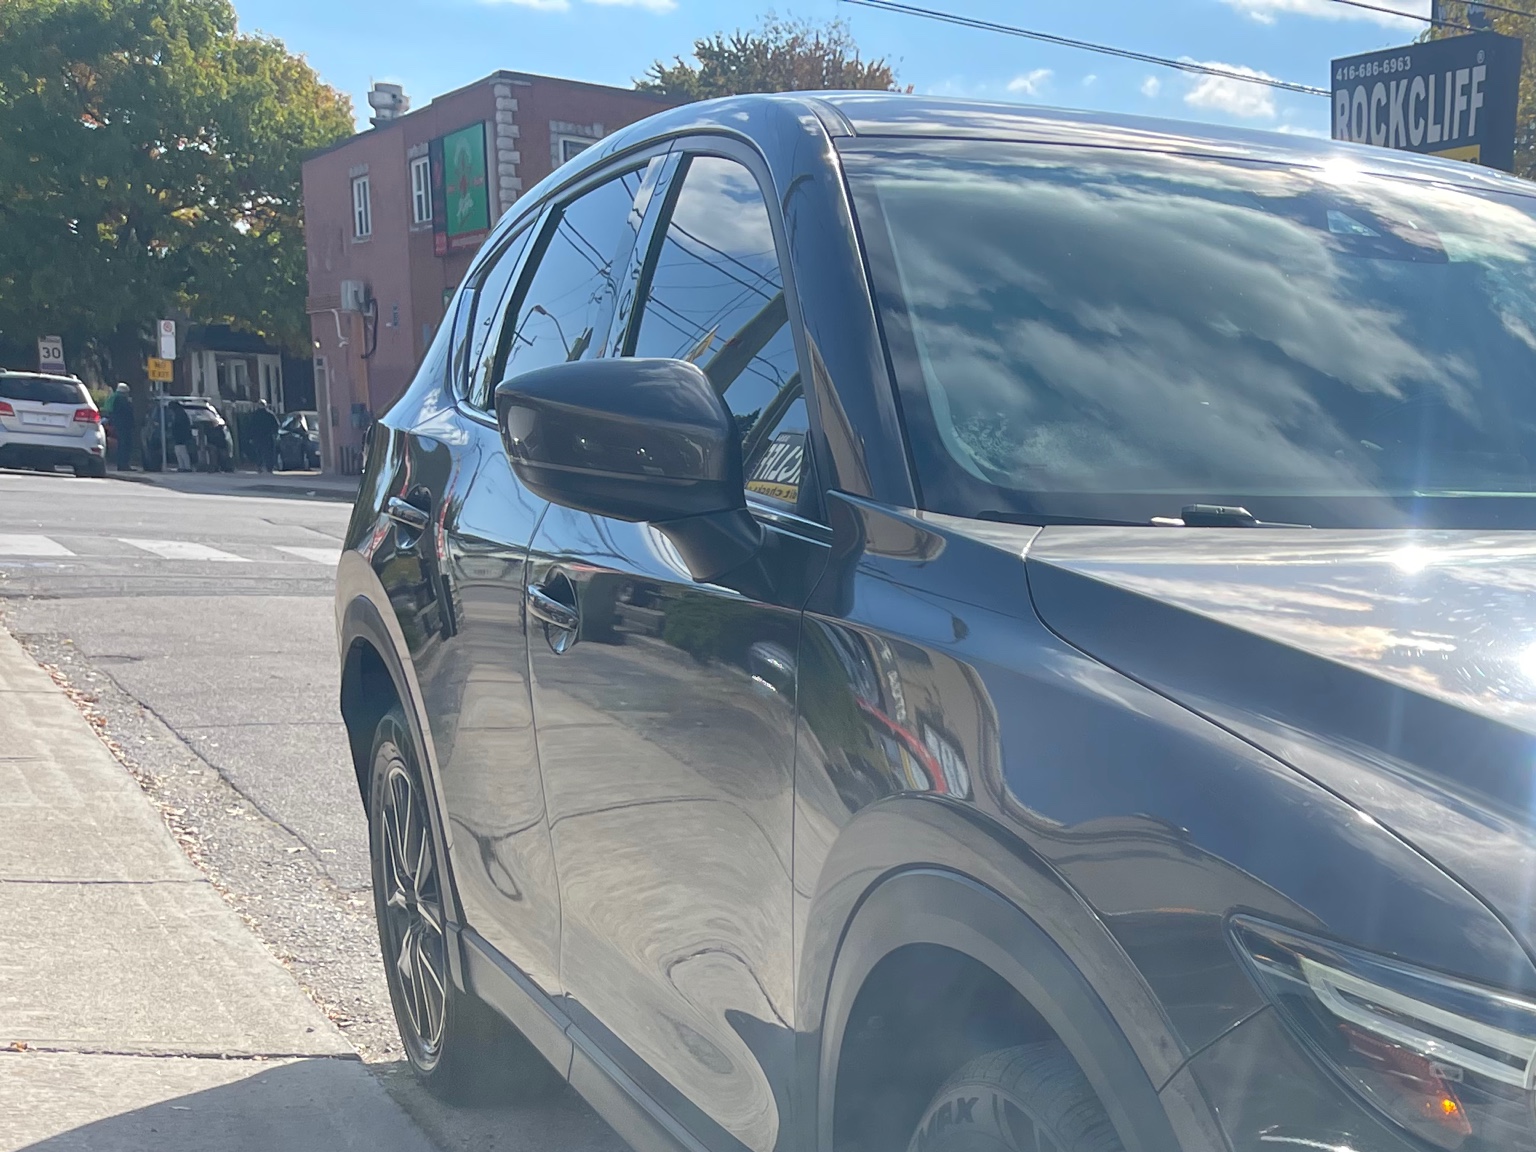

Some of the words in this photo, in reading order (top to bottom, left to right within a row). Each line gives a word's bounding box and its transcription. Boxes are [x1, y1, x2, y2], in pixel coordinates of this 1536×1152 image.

[1335, 55, 1411, 81] 416-686-6963
[1335, 65, 1488, 149] ROCKCLIFF
[41, 346, 61, 359] 30
